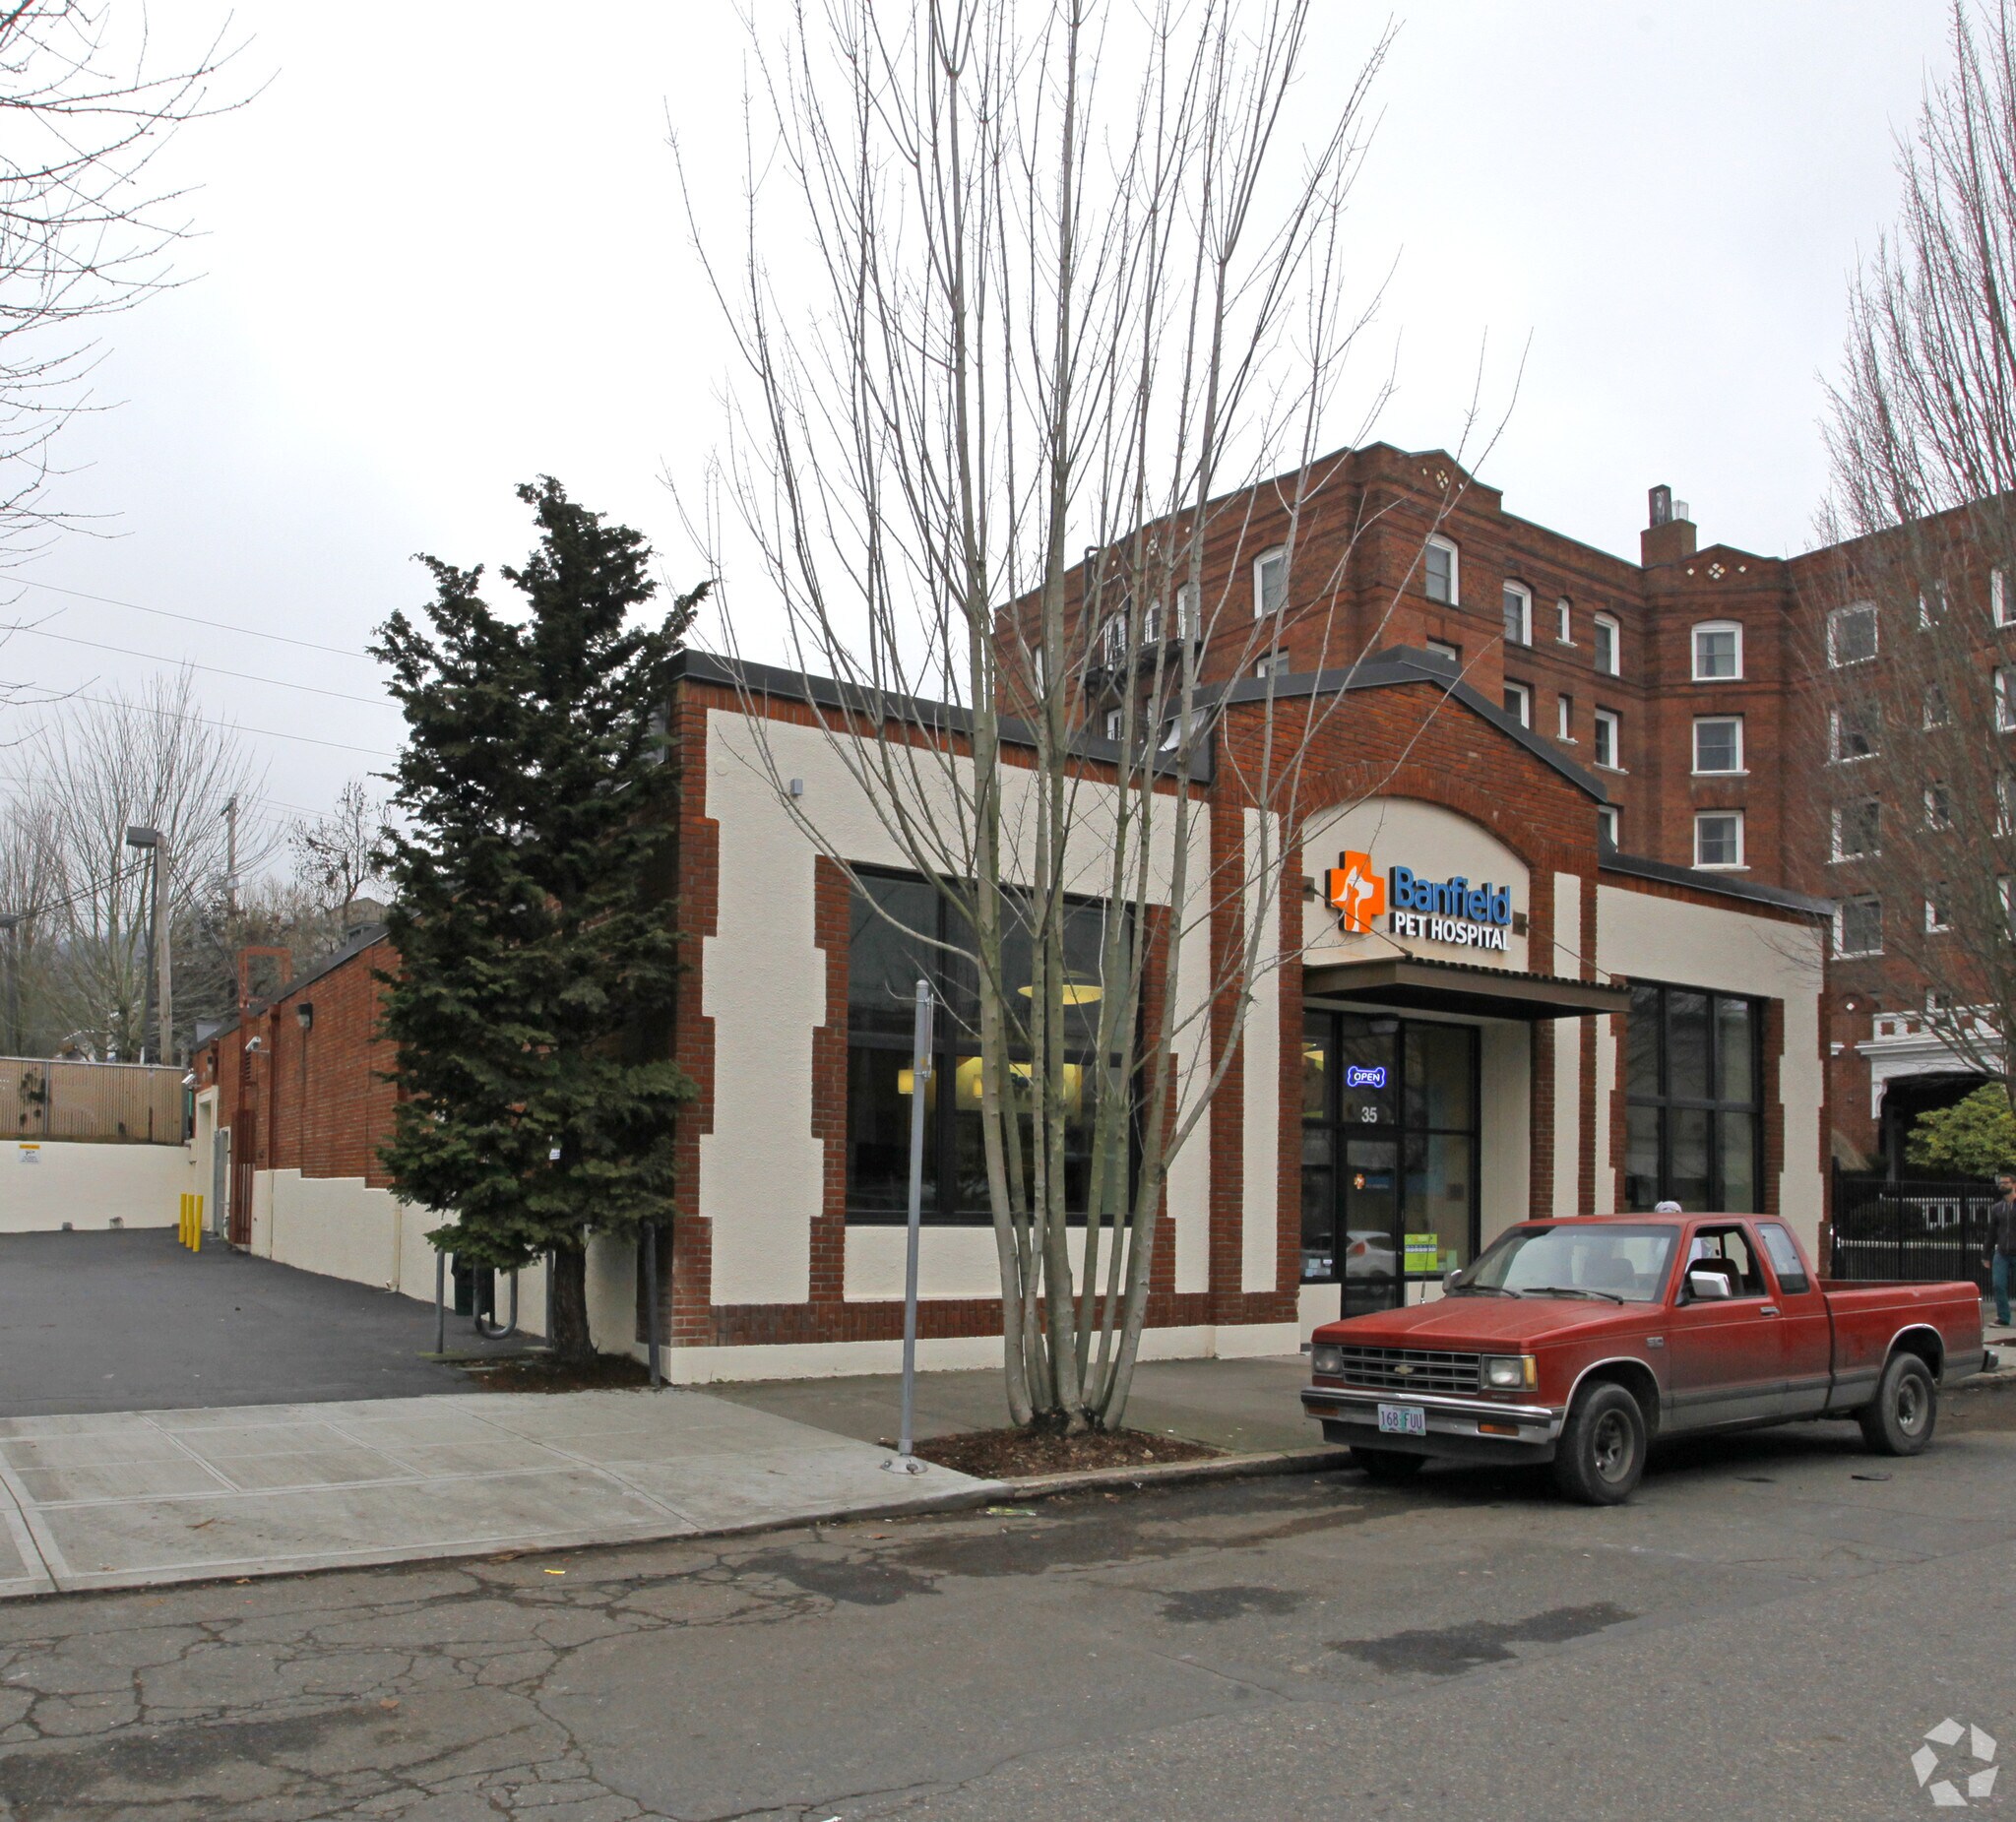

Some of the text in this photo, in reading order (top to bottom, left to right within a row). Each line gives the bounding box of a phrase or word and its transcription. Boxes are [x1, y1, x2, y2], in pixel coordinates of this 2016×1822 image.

[1394, 865, 1512, 925] Banfield
[1395, 911, 1512, 952] PET HOSPITAL
[1354, 1072, 1380, 1082] OPEN
[1361, 1106, 1377, 1123] 35
[1381, 1411, 1422, 1429] 168 FUU
